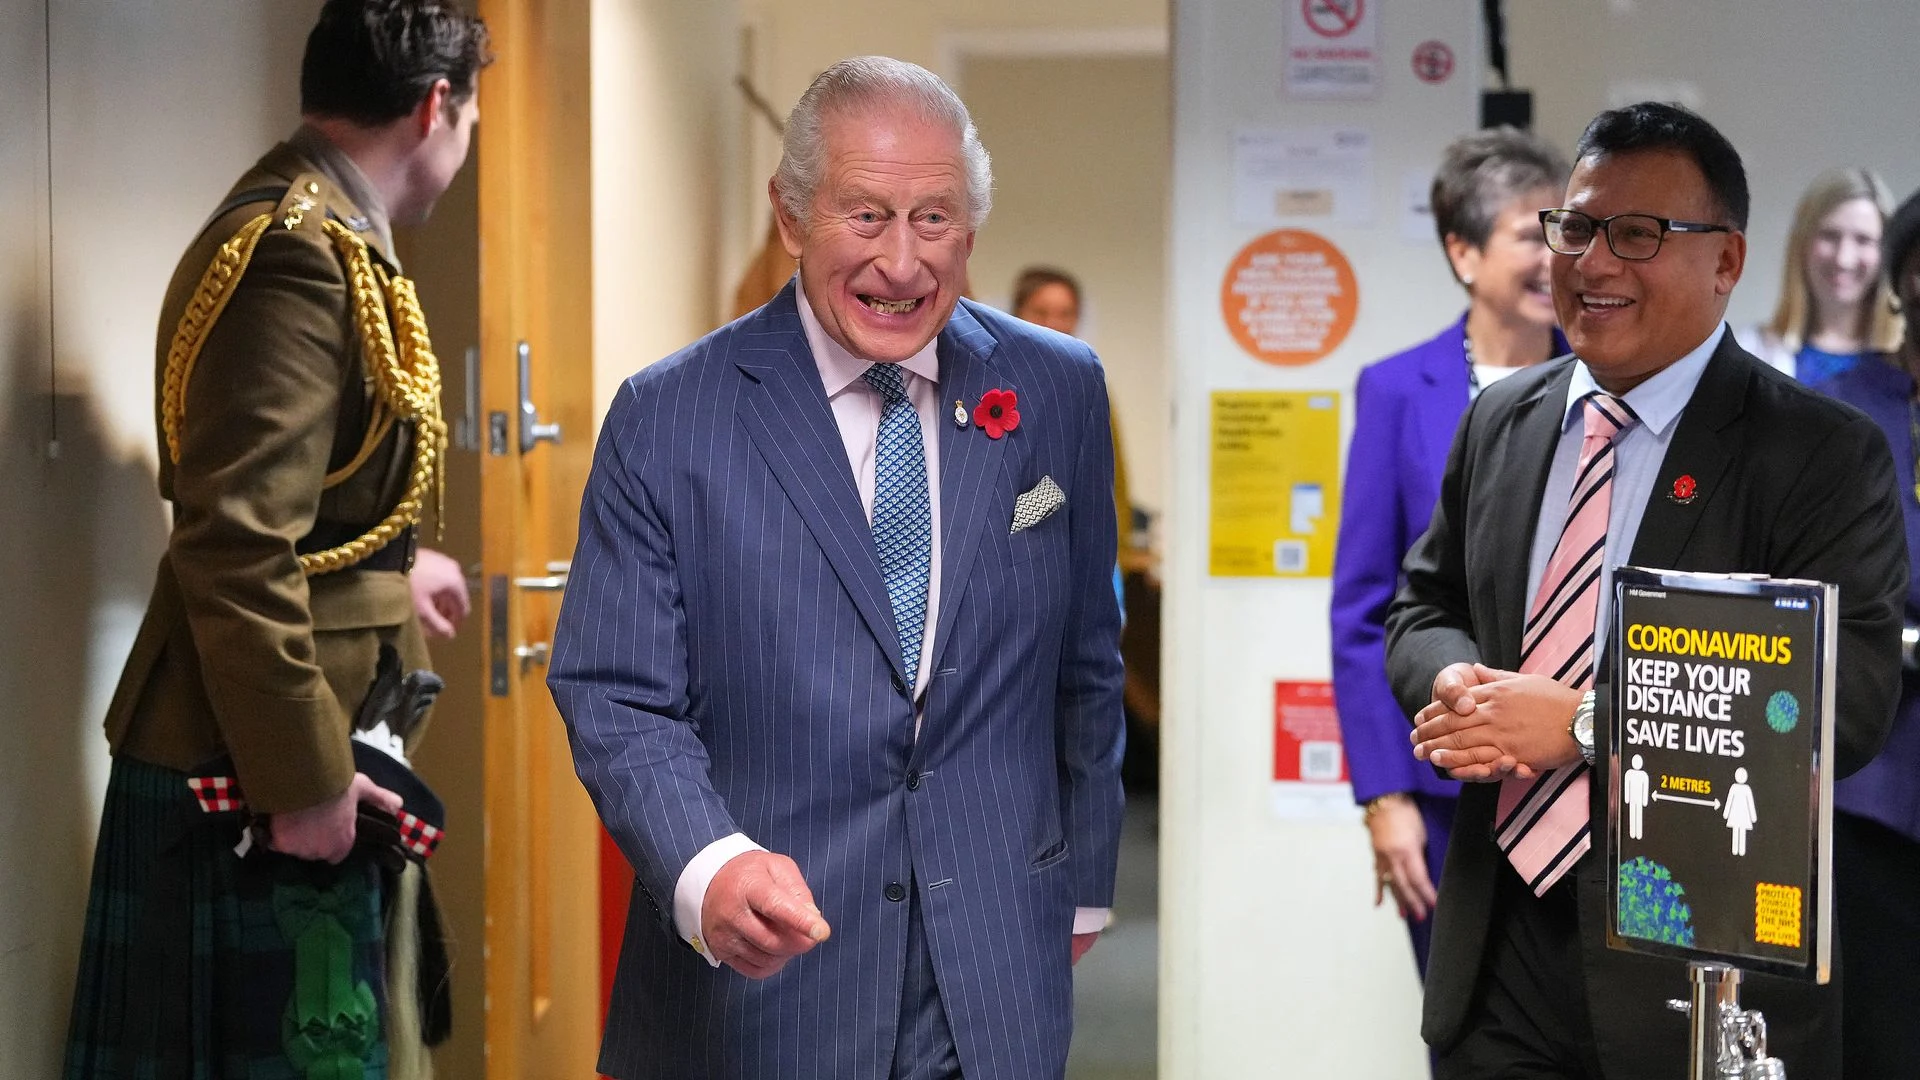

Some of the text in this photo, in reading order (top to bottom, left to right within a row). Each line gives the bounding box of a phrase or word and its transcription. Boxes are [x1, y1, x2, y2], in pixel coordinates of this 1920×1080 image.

[1627, 623, 1792, 665] CORONAVIRUS
[1627, 657, 1751, 696] KEEP YOUR
[1627, 684, 1732, 721] DISTANCE
[1626, 718, 1745, 758] SAVE LIVES
[1660, 774, 1711, 794] 2 METRES
[1760, 889, 1796, 901] PROTECT
[1761, 898, 1796, 909] YOURSELF
[1760, 907, 1788, 917] OTHERS
[1761, 916, 1775, 926] THE
